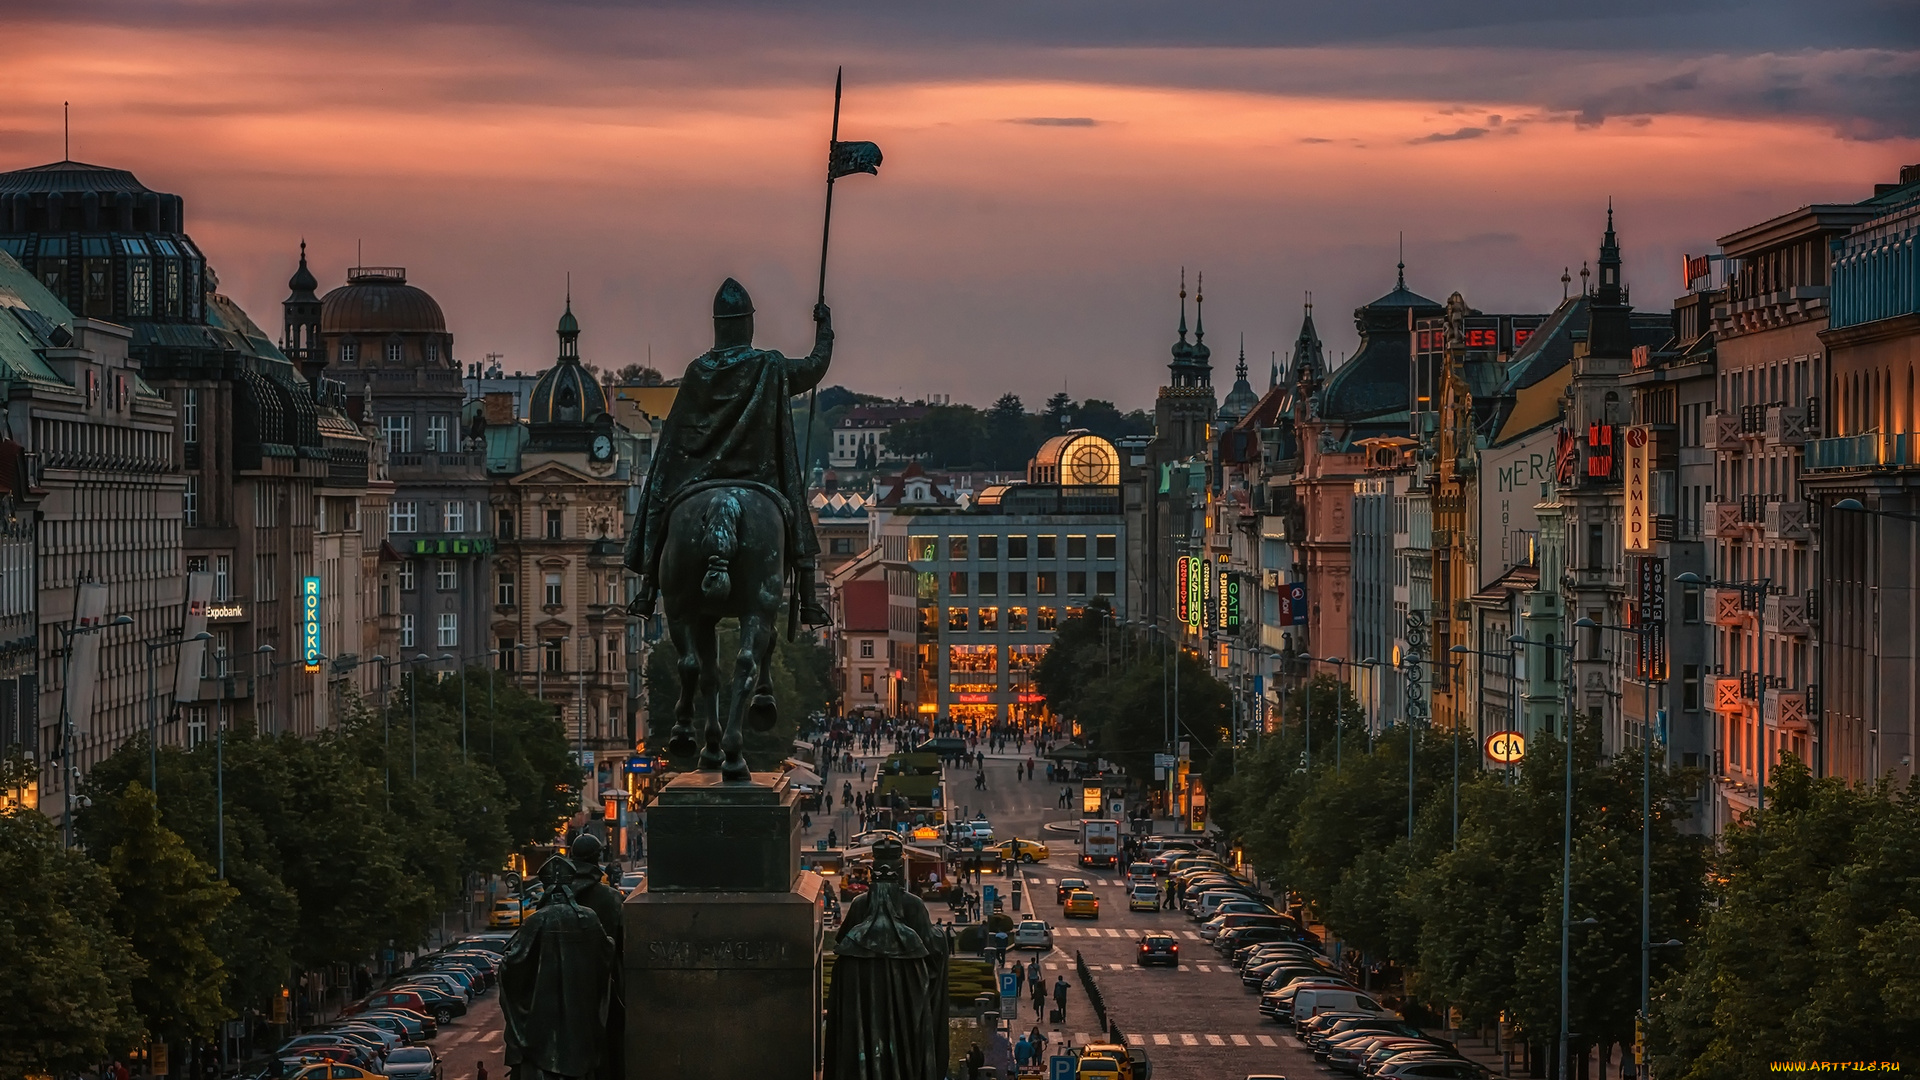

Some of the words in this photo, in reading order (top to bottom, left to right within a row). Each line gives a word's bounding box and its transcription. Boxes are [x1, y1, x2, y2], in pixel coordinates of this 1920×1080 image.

[1630, 457, 1643, 549] RAMADA
[1501, 500, 1509, 561] HOTEL
[206, 605, 243, 620] Expobank
[1191, 562, 1199, 622] CASINO
[1219, 572, 1228, 628] McDonald's
[1228, 582, 1239, 625] GATE
[1653, 563, 1664, 620] Elysee
[307, 582, 318, 660] ROKOKO
[1493, 740, 1522, 755] C&A
[985, 887, 993, 897] P
[1003, 976, 1014, 990] P
[1056, 1060, 1071, 1080] P
